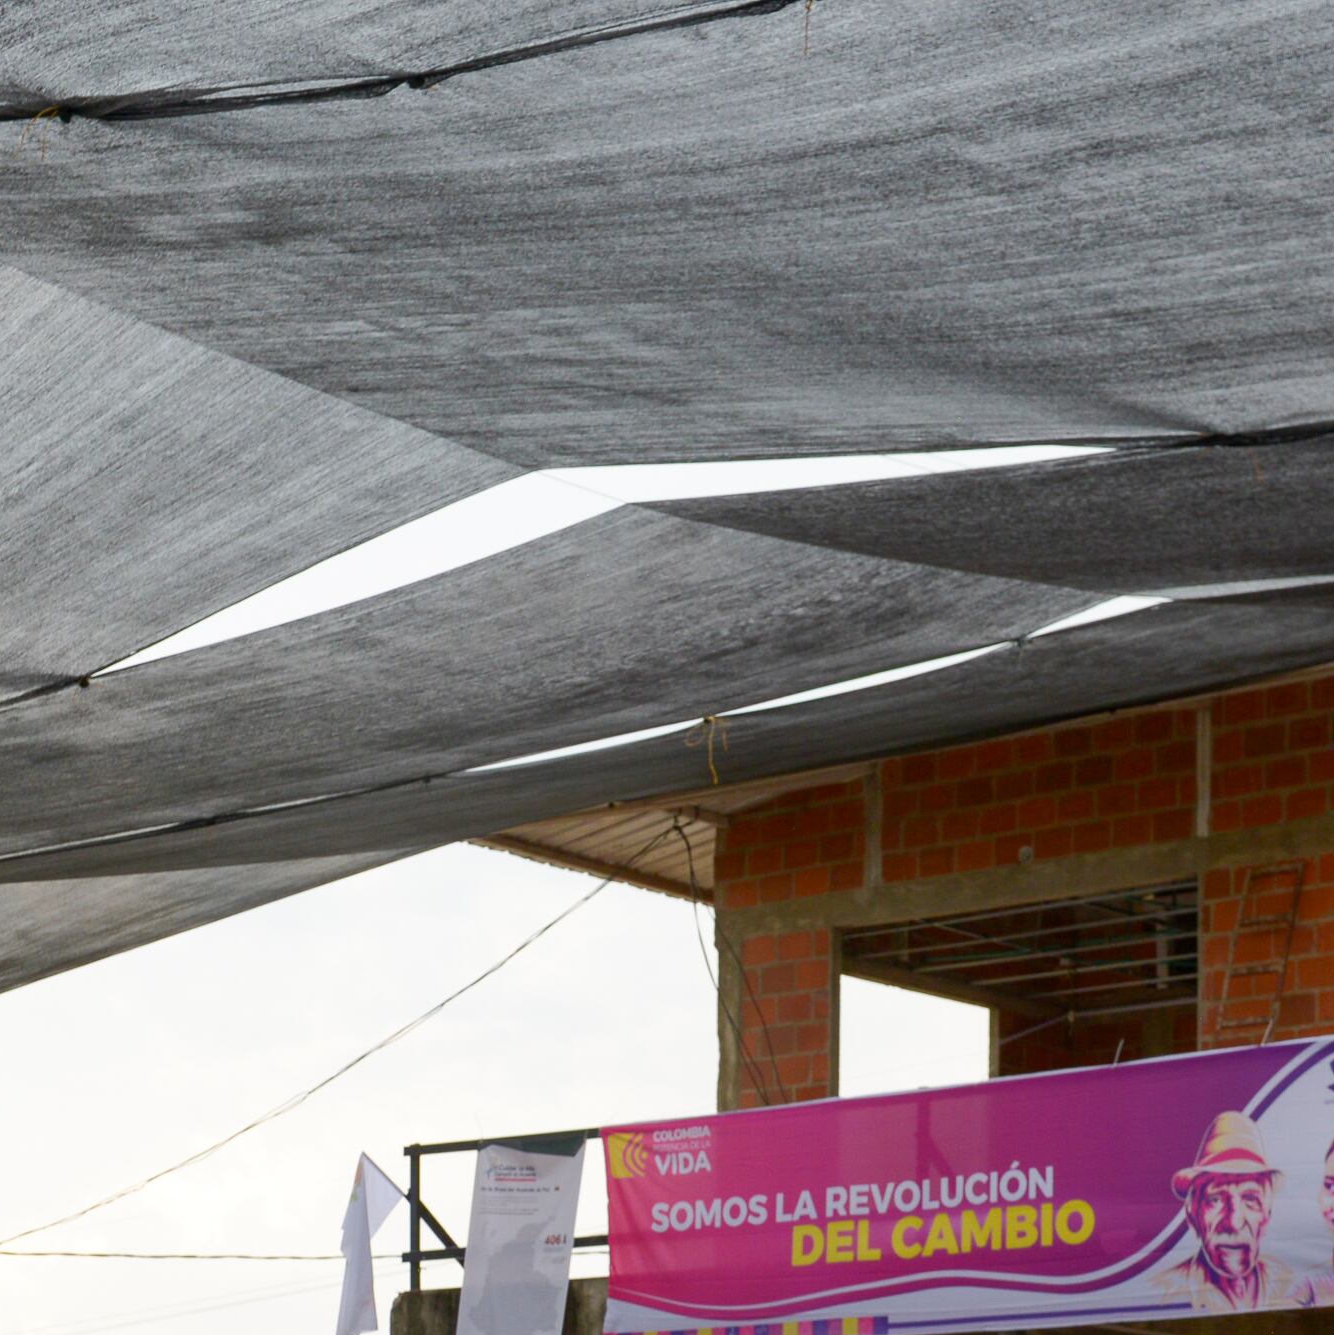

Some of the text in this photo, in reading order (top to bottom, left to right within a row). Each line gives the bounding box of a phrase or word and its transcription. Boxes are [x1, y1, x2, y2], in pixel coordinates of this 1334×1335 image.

[652, 1125, 711, 1143] COLOMBIA
[654, 1150, 711, 1176] VIDA
[650, 1161, 1055, 1234] SOMOS LA REVOLUCIÓN
[791, 1199, 1096, 1267] DEL CAMBIO
